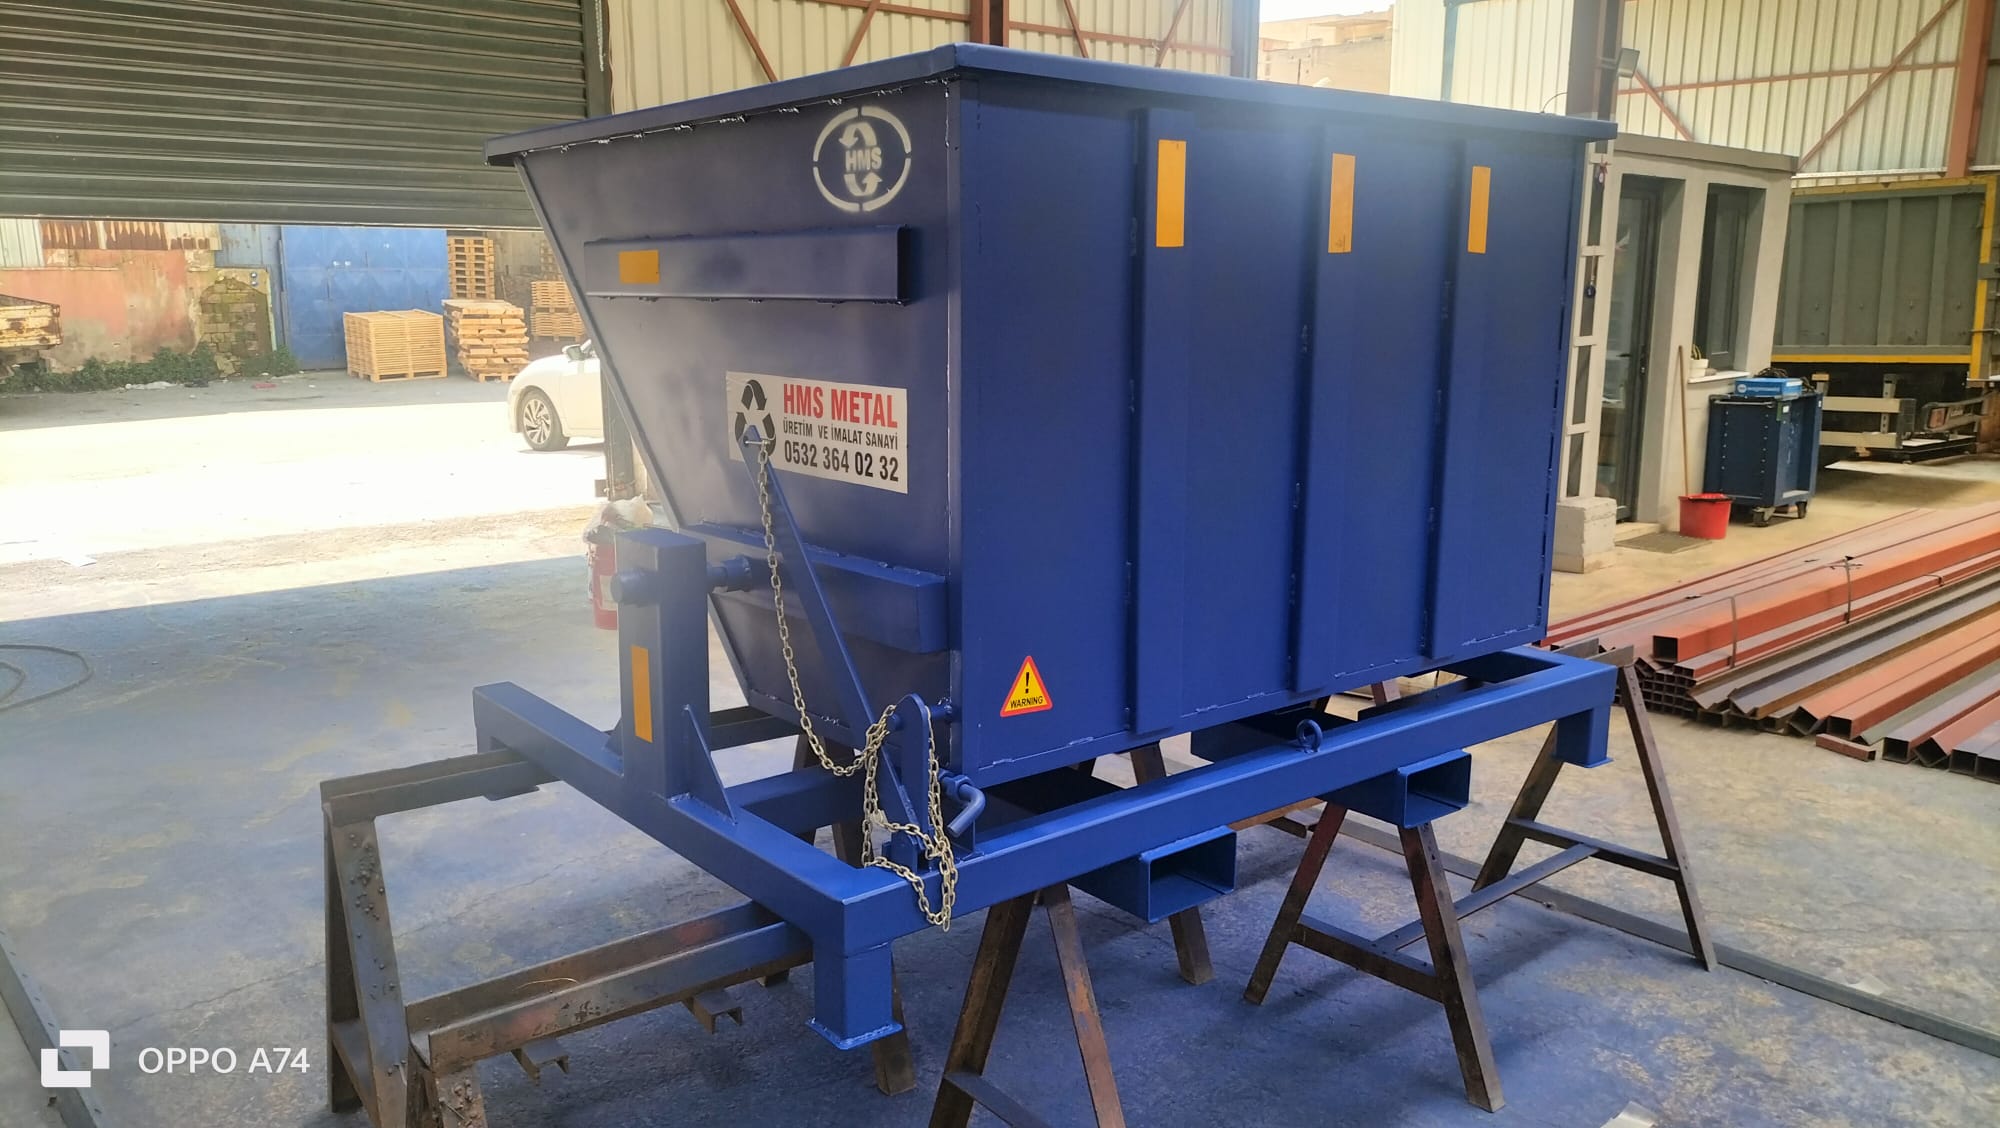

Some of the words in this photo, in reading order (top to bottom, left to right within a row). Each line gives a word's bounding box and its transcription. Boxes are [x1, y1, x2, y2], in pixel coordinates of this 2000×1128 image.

[845, 146, 882, 172] HMS
[783, 383, 824, 419] HMS
[830, 388, 898, 429] METAL
[783, 417, 813, 438] ÜRETİM
[818, 424, 828, 440] VE
[831, 424, 863, 445] İMALAT
[865, 432, 898, 451] SANAYİ
[784, 439, 818, 468] 0532
[822, 446, 850, 473] 364
[854, 451, 874, 478] 02
[879, 455, 899, 482] 32
[1010, 695, 1044, 709] WARNING
